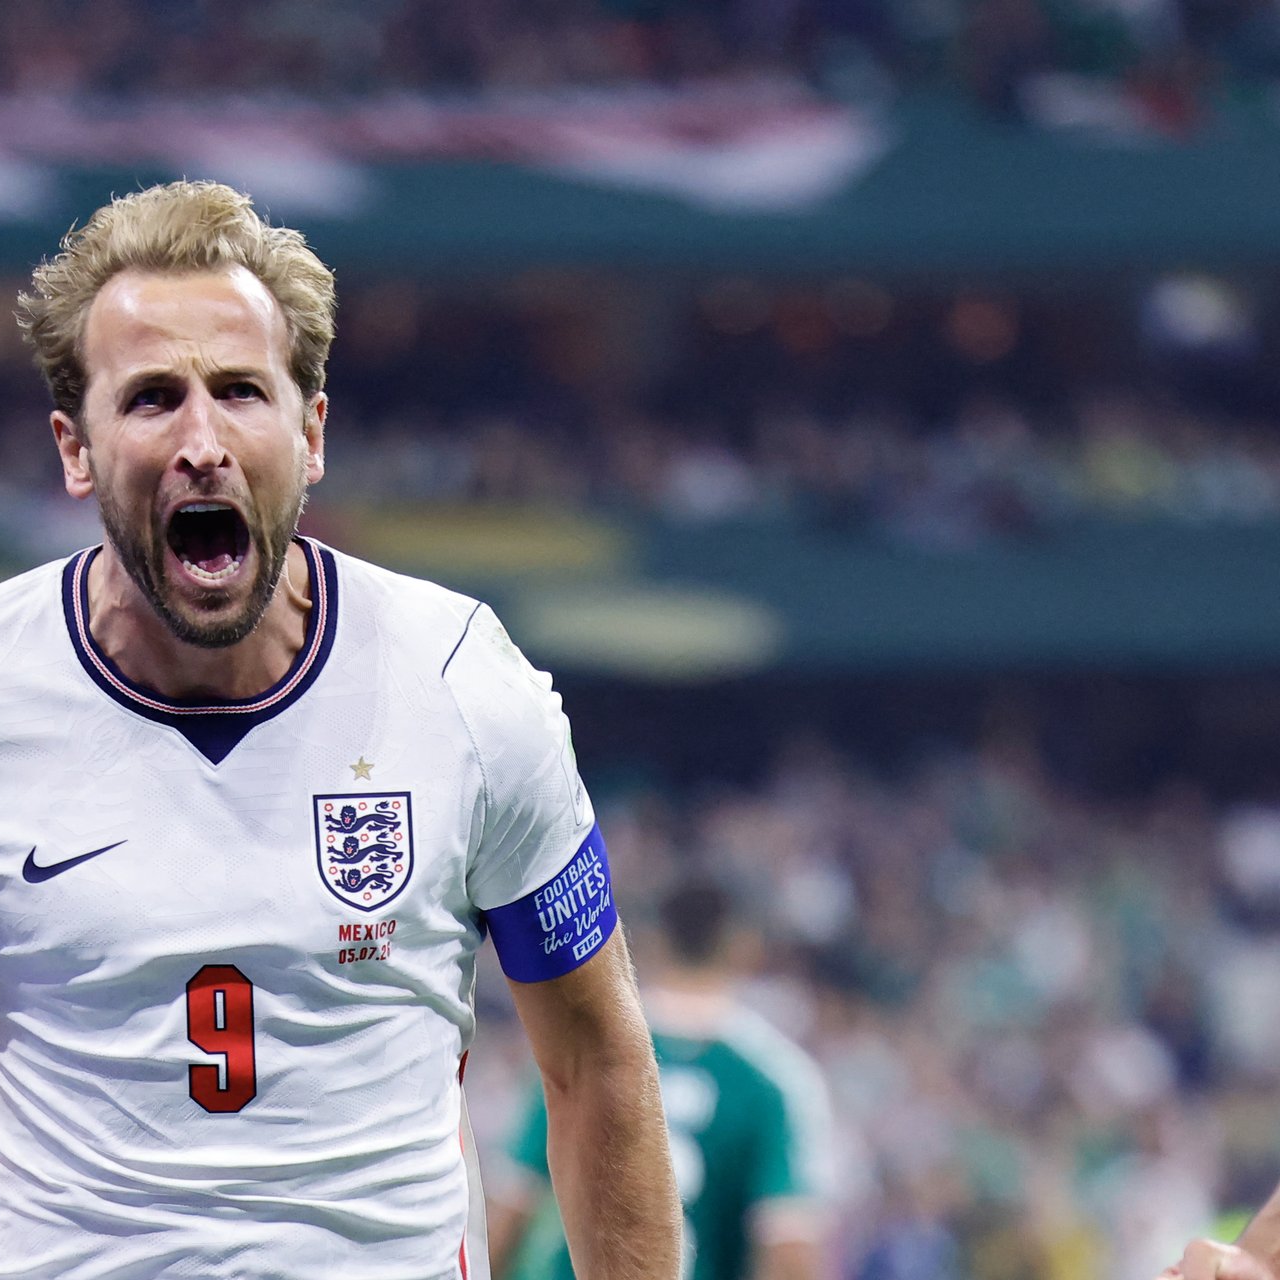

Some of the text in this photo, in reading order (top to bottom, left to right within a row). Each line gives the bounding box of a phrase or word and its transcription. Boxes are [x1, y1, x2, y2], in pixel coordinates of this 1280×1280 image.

[533, 845, 599, 910] FOOTBALL
[538, 862, 606, 933] UNITES
[338, 919, 397, 942] MEXICO
[539, 882, 611, 955] the World
[575, 930, 601, 958] FIFA
[185, 963, 257, 1113] 9
